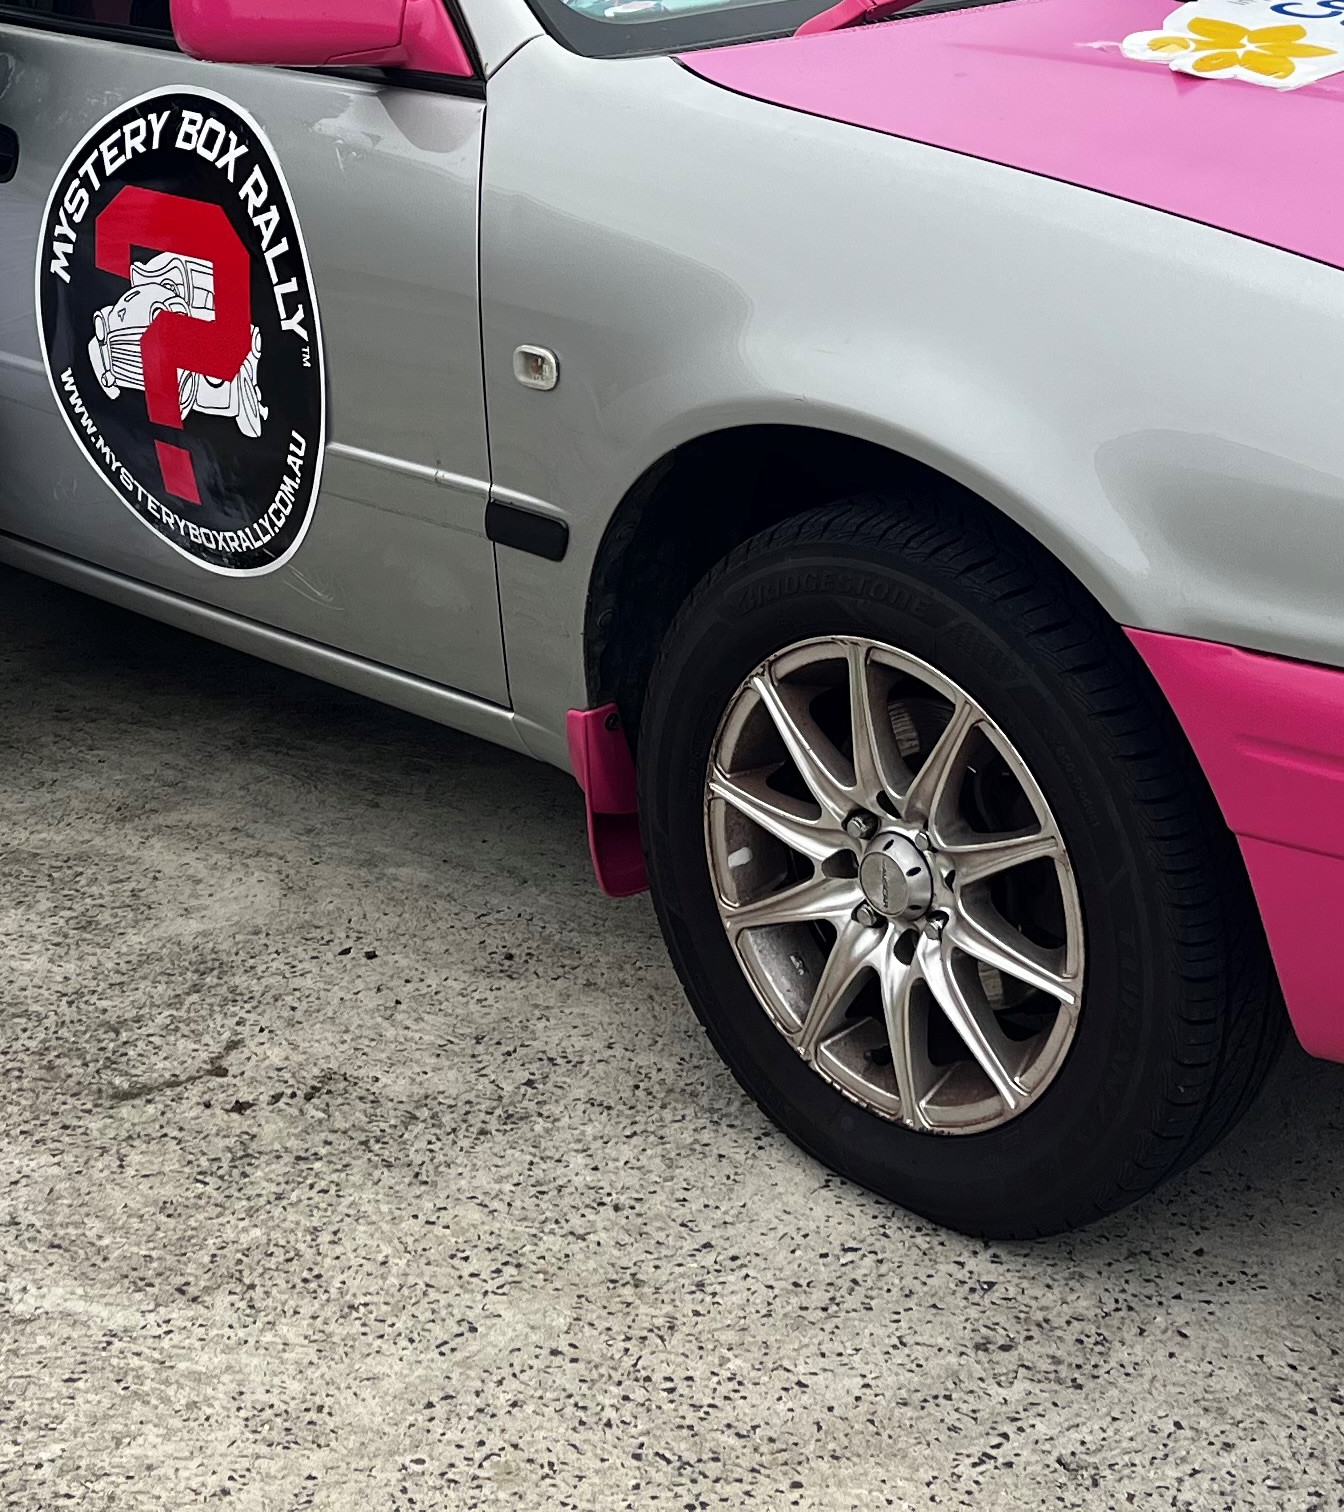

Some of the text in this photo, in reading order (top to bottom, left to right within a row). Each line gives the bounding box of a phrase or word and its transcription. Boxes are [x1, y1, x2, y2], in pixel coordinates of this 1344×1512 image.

[51, 110, 171, 284] MYSTERY
[175, 109, 250, 183] BOX
[62, 366, 307, 553] WWW.MYSTERYBOXRALLY.COM.AU
[737, 571, 931, 618] BRIDGESTONE
